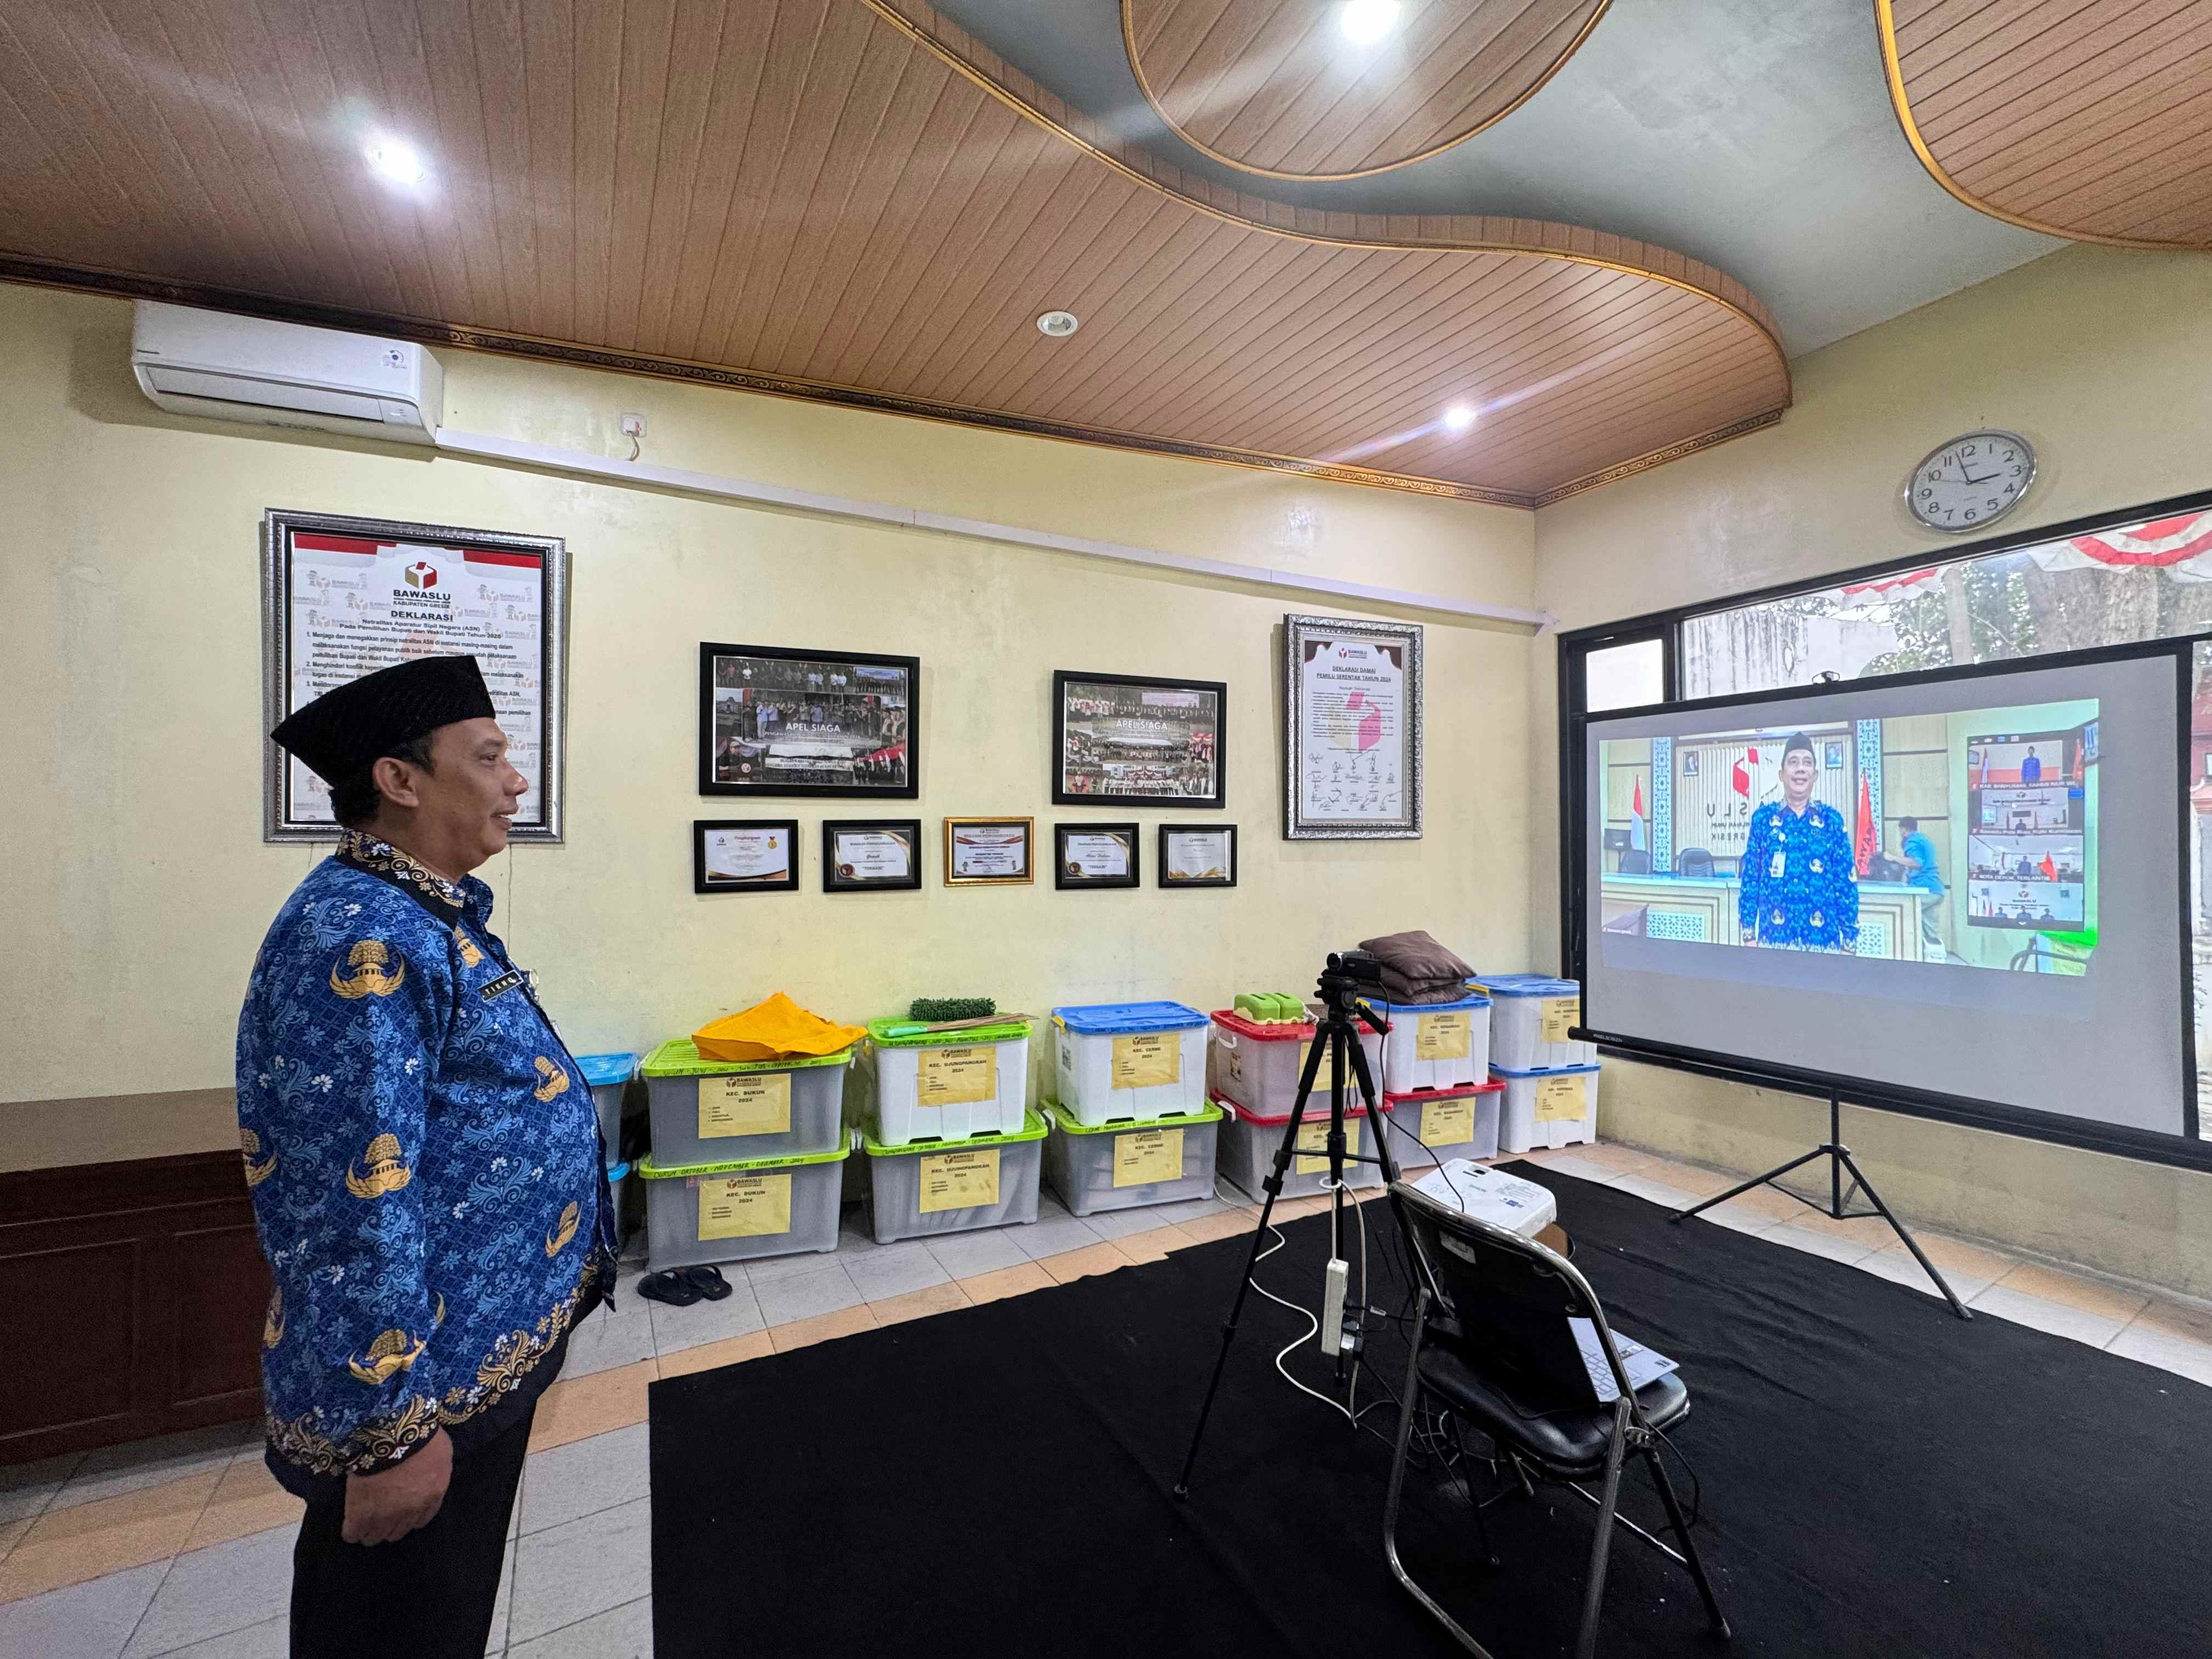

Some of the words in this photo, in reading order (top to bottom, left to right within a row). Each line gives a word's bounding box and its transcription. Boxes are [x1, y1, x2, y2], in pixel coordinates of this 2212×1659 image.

[1961, 445, 1975, 458] 12
[1989, 444, 1992, 454] 1
[1944, 456, 1952, 467] 11
[2003, 450, 2014, 462] 2
[1928, 470, 1942, 482] 10
[2010, 465, 2022, 477] 3
[1921, 488, 1932, 499] 9
[2004, 483, 2015, 494] 4
[1928, 502, 1939, 514] 8
[1987, 498, 1998, 510] 5
[1944, 509, 1954, 521] 7
[1965, 509, 1976, 520] 6
[393, 589, 450, 600] BAWASLU
[391, 611, 453, 621] DEKLARASI
[786, 723, 809, 731] APEL
[811, 724, 840, 732] SIAGA
[1115, 719, 1136, 729] APEL
[1141, 721, 1167, 730] SIAGA
